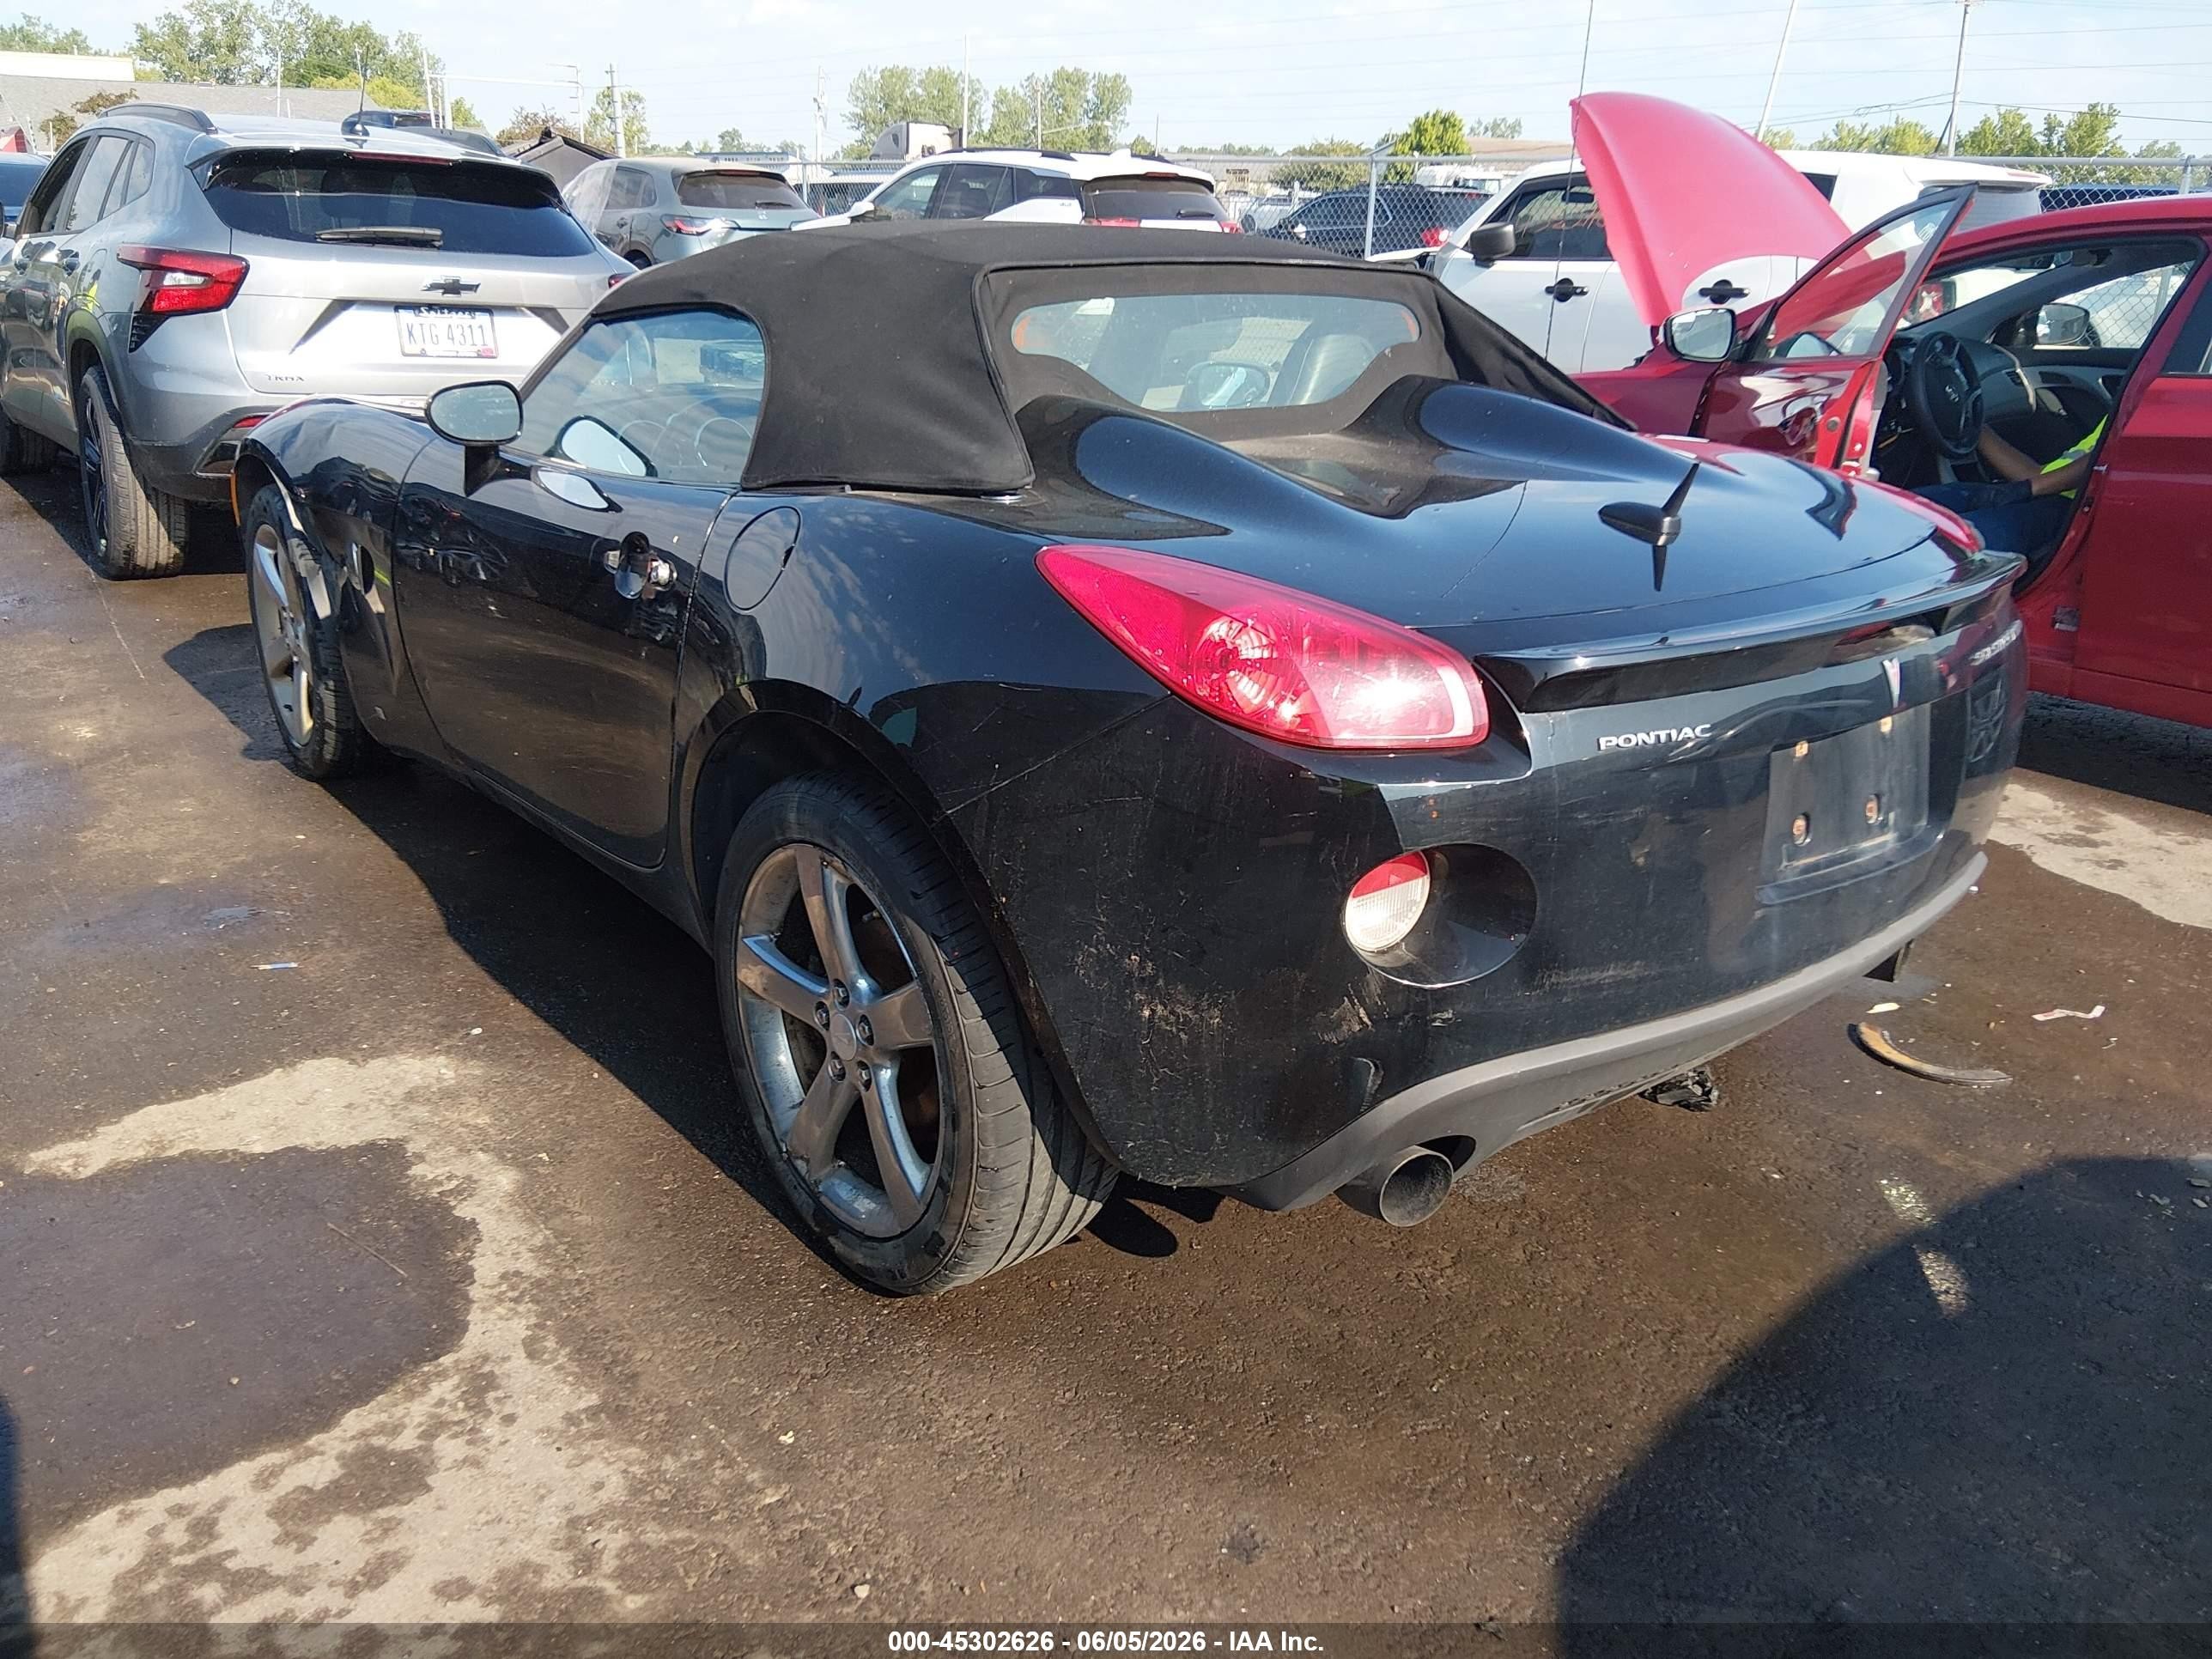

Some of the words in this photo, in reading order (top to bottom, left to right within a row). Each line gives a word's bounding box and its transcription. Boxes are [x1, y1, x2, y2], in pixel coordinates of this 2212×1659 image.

[406, 323, 440, 345] KTG
[447, 324, 489, 347] 4311
[1597, 723, 1712, 751] PONTIAC
